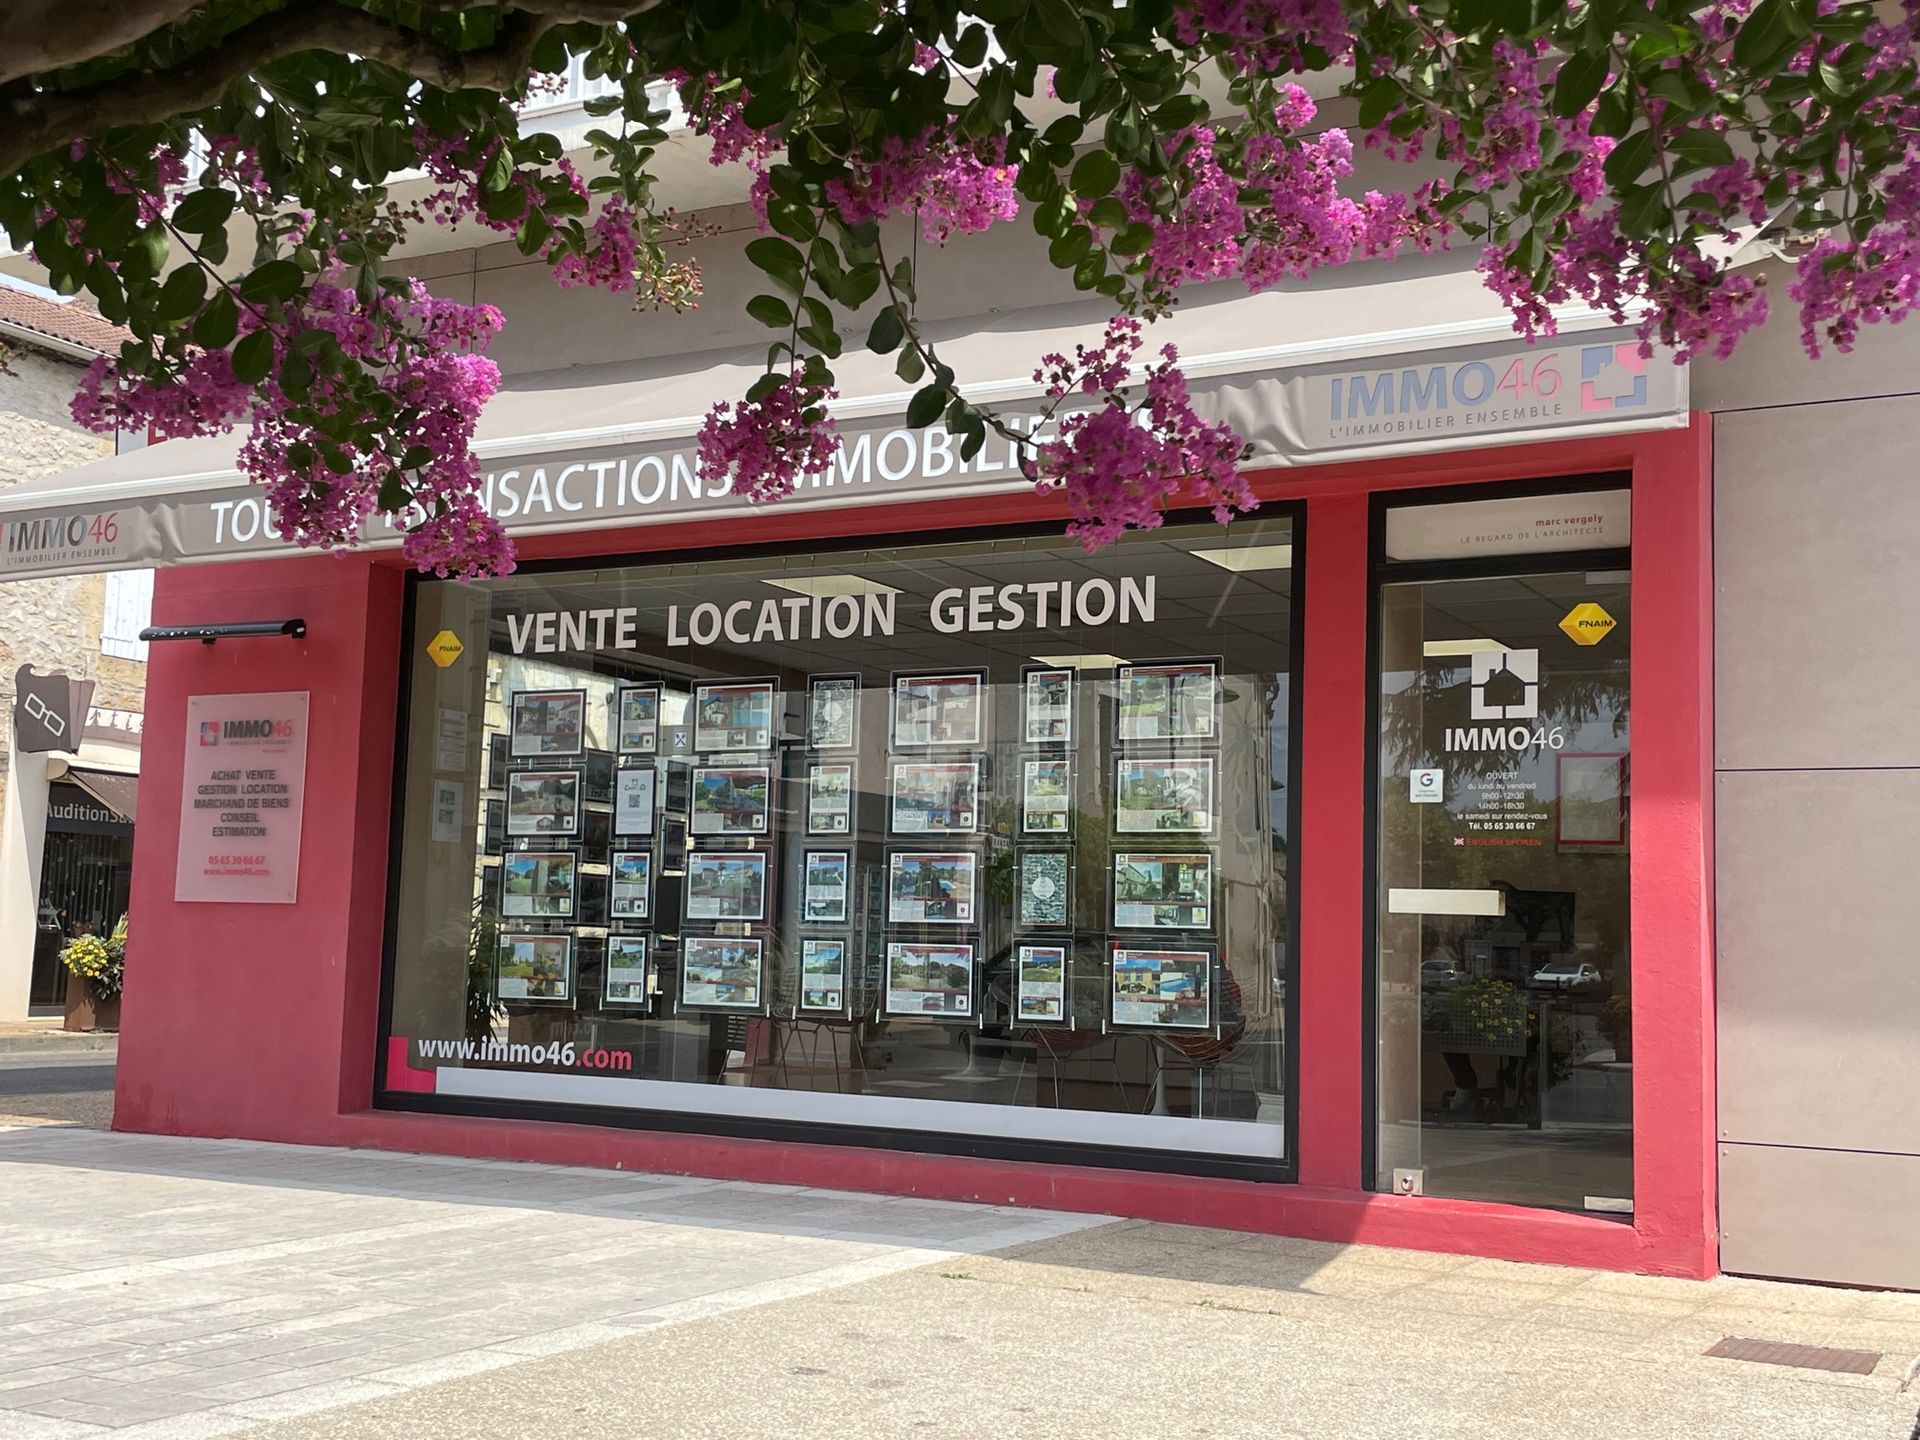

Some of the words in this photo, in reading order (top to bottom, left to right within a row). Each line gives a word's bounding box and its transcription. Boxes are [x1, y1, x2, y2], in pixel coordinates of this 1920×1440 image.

[1331, 353, 1562, 421] IMMO46
[1330, 415, 1455, 439] L'IMMOBILIER
[1465, 403, 1562, 425] ENSEMBLE
[1536, 517, 1561, 527] marc
[1564, 513, 1604, 525] vergely
[8, 512, 119, 553] IMMO46
[1460, 536, 1471, 544] LE
[1475, 534, 1513, 542] REGARD
[1518, 532, 1529, 540] DE
[71, 546, 117, 560] ENSEMBLE
[506, 606, 638, 655] VENTE
[667, 592, 896, 647] LOCATION
[929, 574, 1156, 635] GESTION
[1578, 619, 1613, 629] FNAIM
[223, 719, 293, 739] IMMO46
[1445, 726, 1565, 752] IMMO46
[210, 770, 241, 781] ACHAT
[245, 769, 276, 780] VENTE
[1486, 771, 1518, 780] OUVERT
[197, 784, 237, 795] GESTION
[241, 784, 288, 794] LOCATION
[1507, 782, 1537, 790] vendredi
[194, 799, 245, 809] MARCHAND
[247, 799, 259, 809] DE
[261, 798, 289, 808] BIENS
[220, 812, 259, 823] CONSEIL
[212, 826, 266, 837] ESTIMATION
[1483, 822, 1493, 830] 05
[1494, 822, 1504, 830] 65
[1505, 822, 1514, 830] 30
[418, 1035, 632, 1071] www.immo46.com
